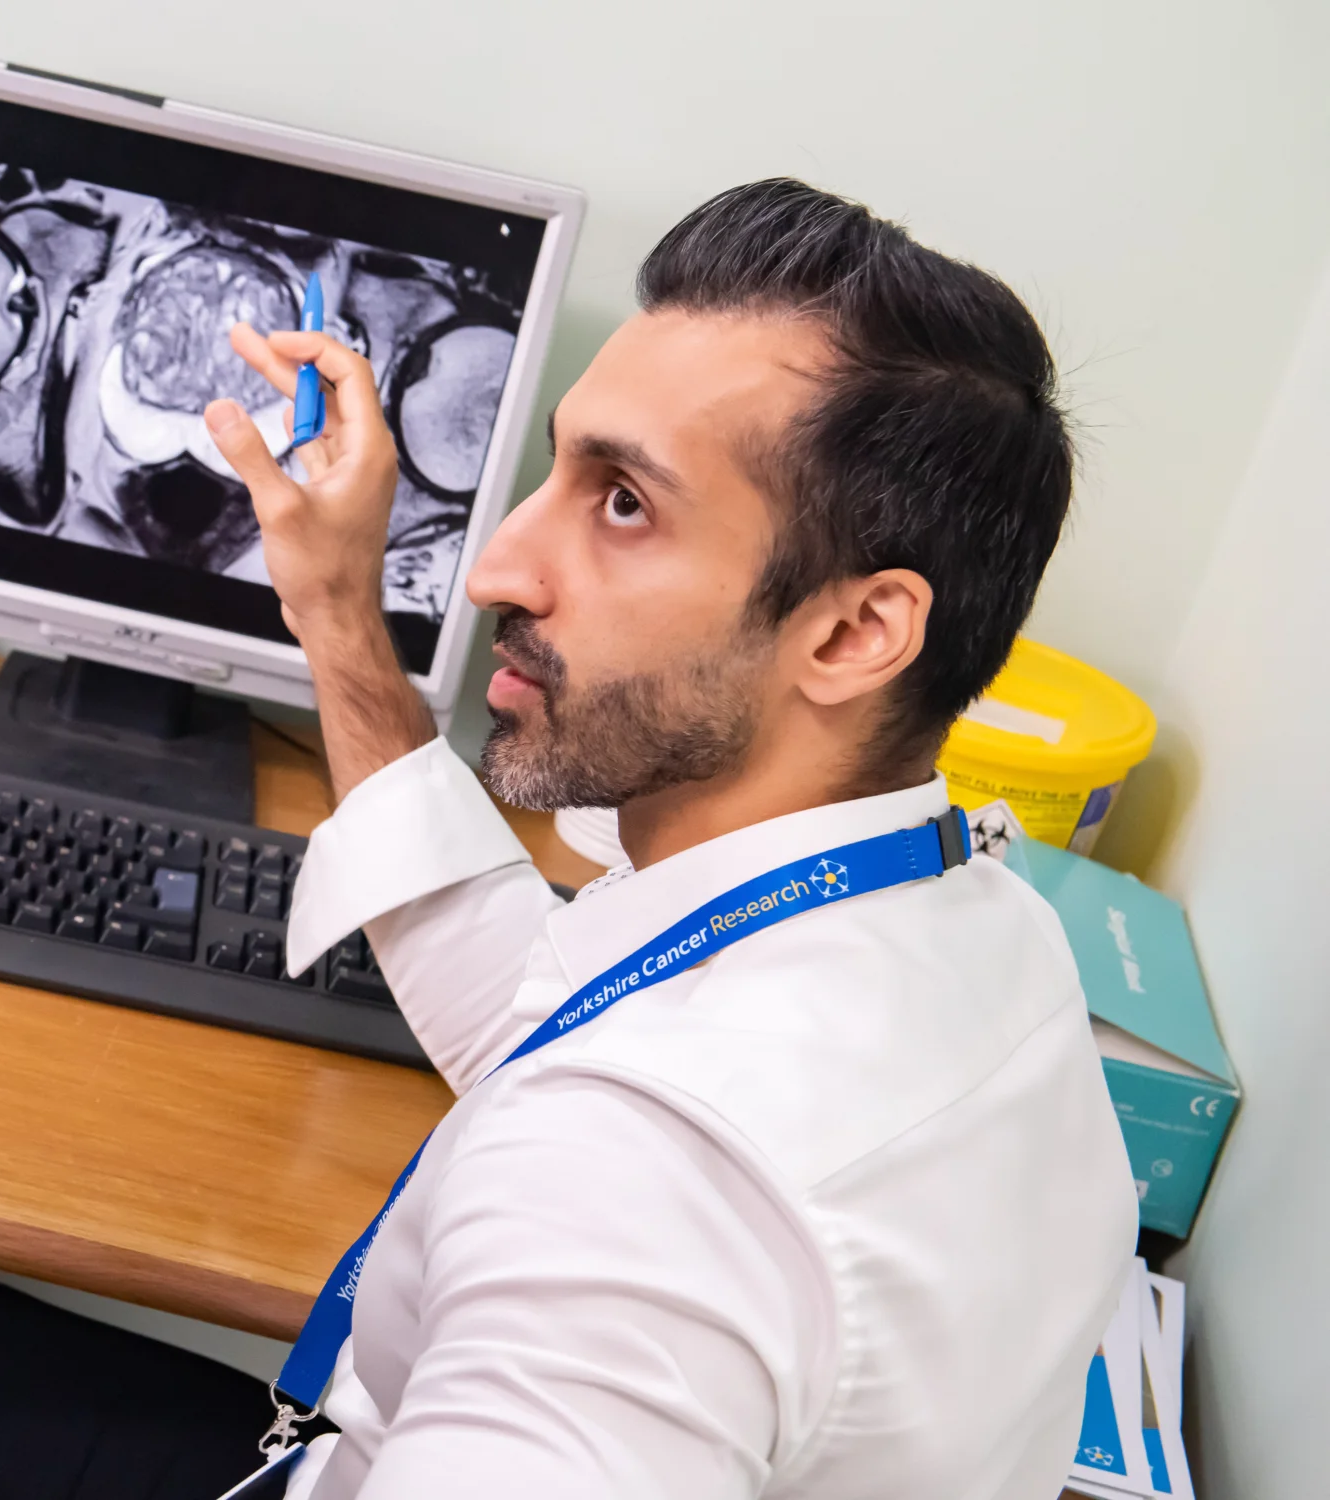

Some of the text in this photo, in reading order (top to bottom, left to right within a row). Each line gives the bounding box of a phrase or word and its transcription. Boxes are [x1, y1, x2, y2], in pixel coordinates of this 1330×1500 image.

[1000, 786, 1037, 800] ABOVE
[556, 879, 811, 1031] Yorkshire Cancer Research
[336, 1240, 373, 1303] Yorkshi
